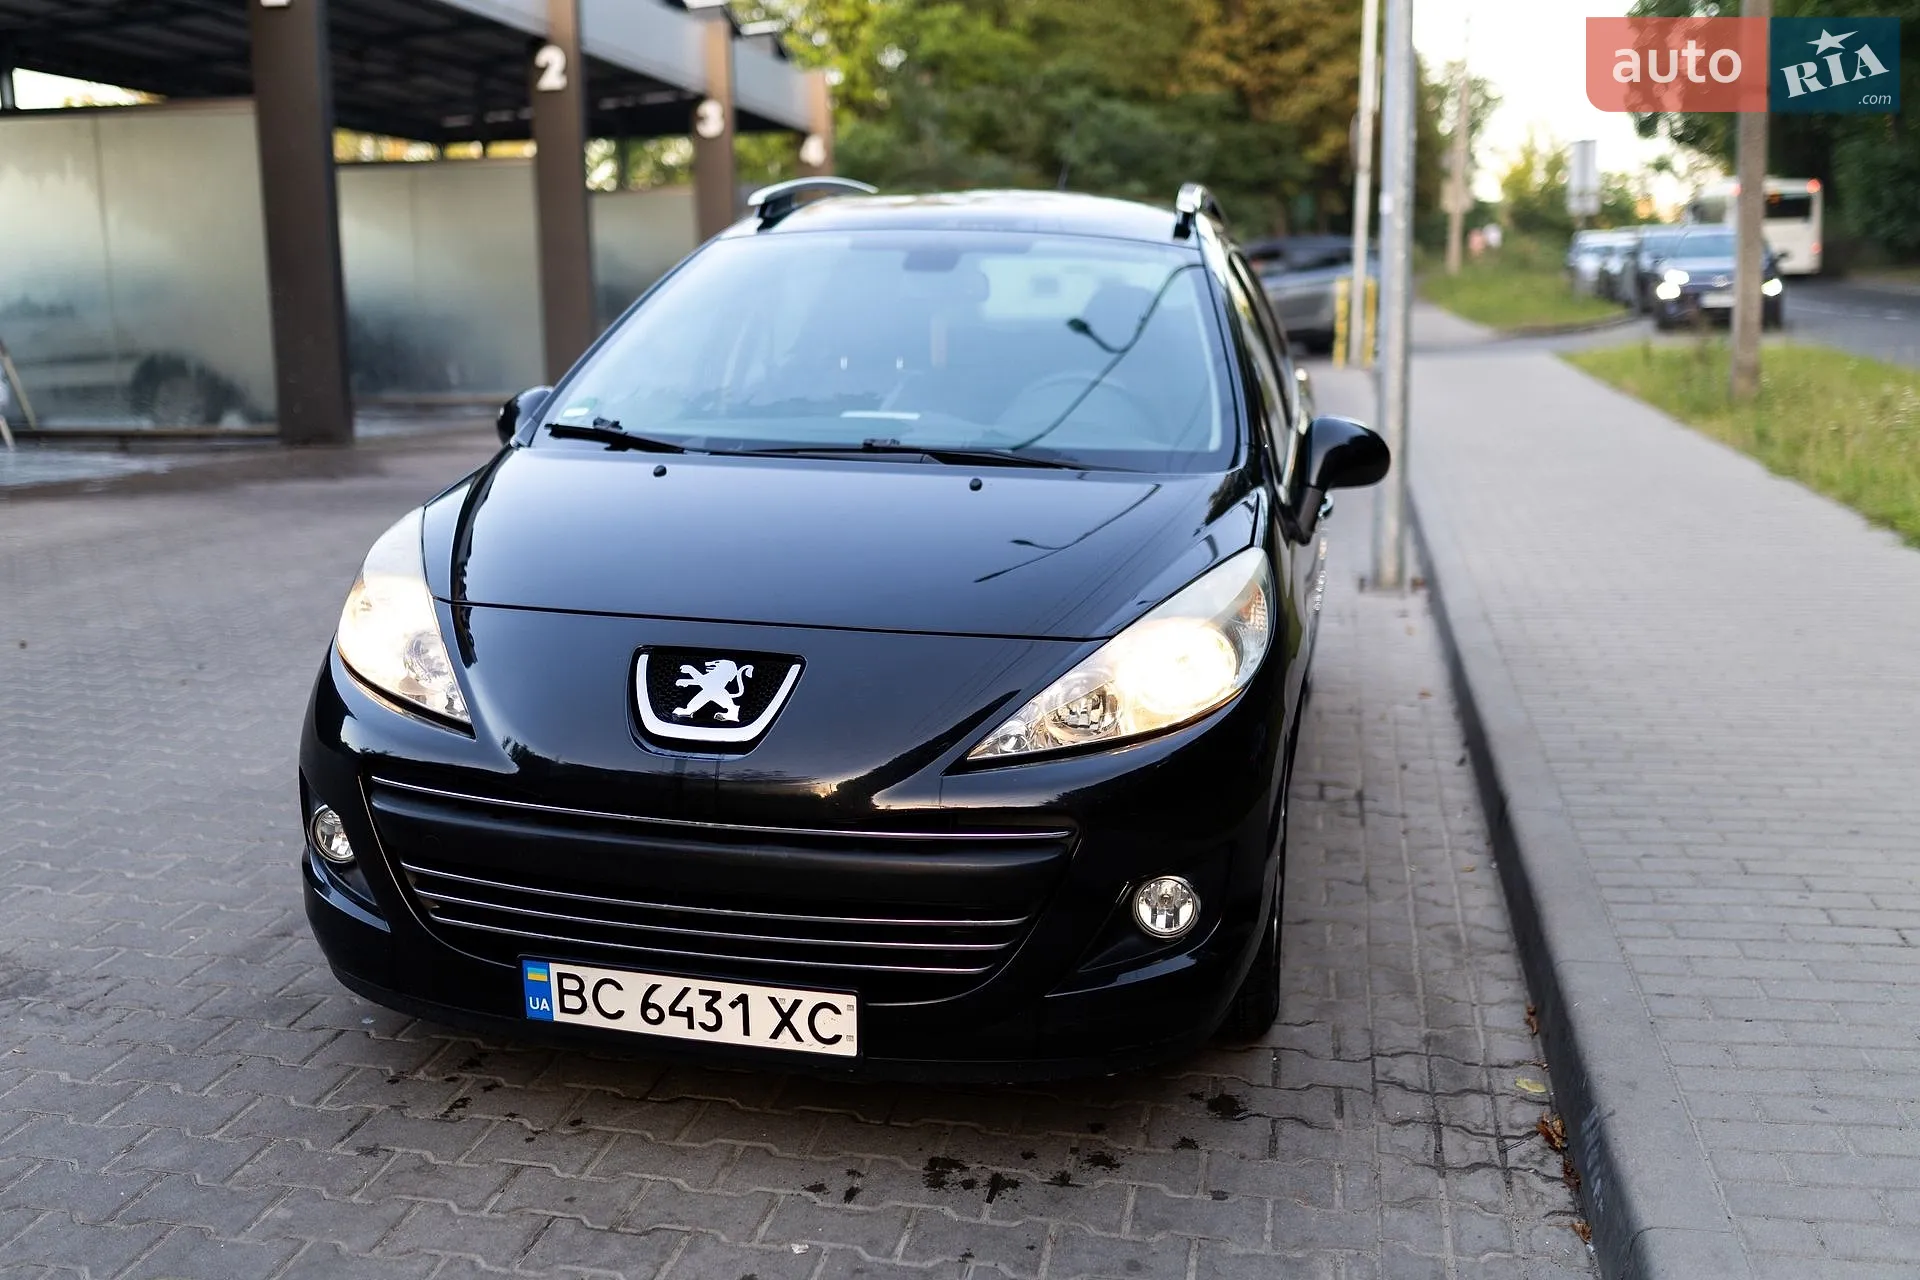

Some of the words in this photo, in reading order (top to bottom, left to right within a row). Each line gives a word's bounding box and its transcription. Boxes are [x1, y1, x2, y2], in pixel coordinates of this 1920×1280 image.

[535, 45, 567, 91] 2
[696, 100, 725, 138] 3
[529, 997, 550, 1011] UA
[556, 971, 625, 1020] BC
[640, 983, 751, 1037] 6431
[767, 995, 843, 1045] XC
